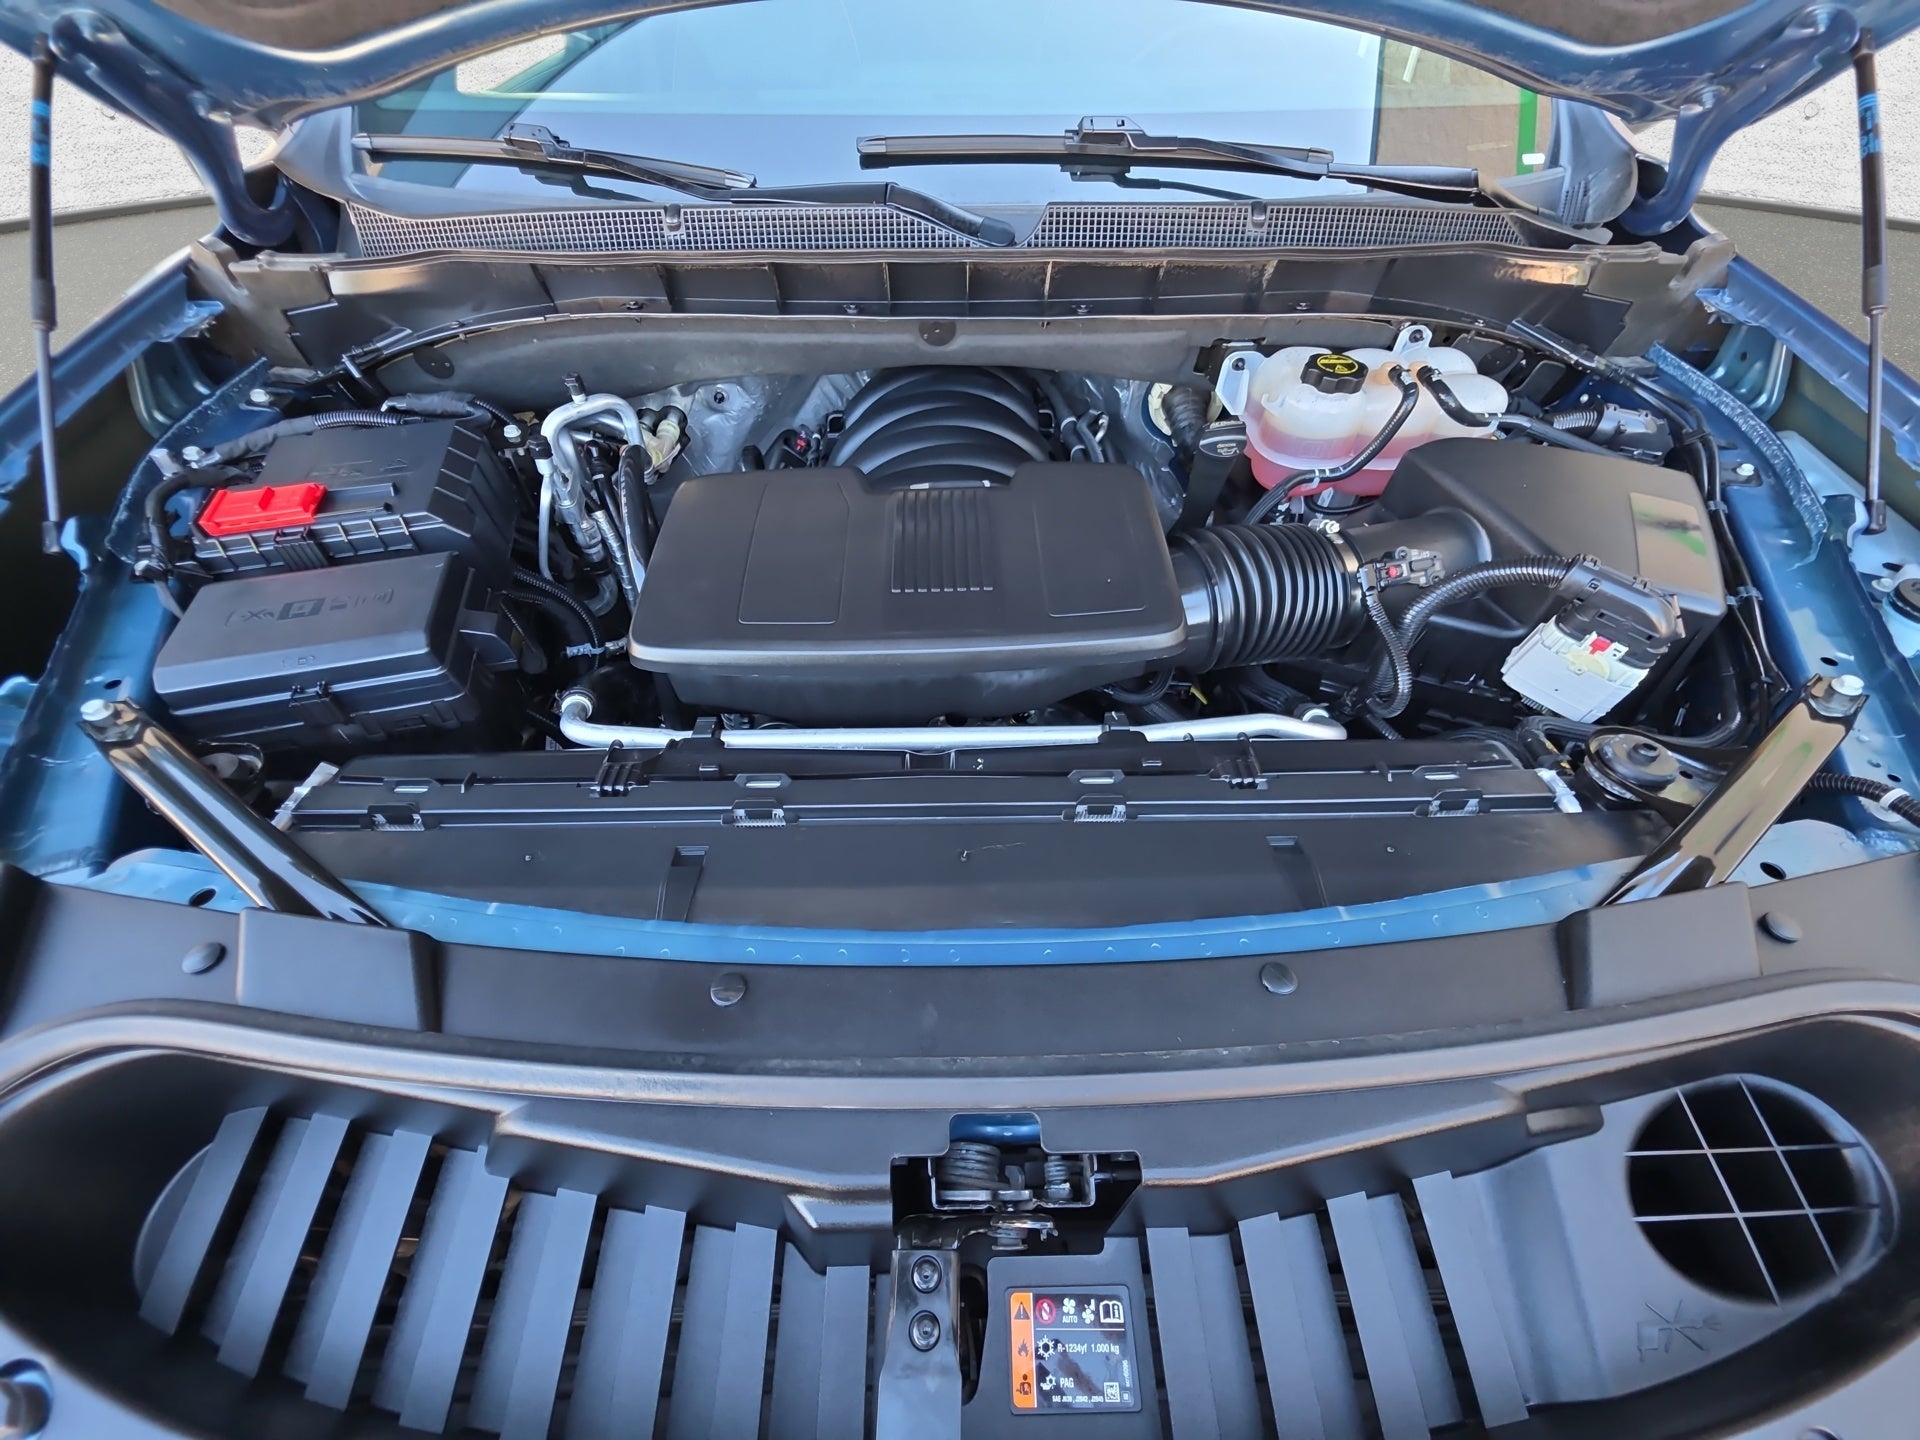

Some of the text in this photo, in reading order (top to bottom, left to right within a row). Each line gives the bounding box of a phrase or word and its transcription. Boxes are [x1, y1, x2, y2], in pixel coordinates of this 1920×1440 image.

[1062, 1315, 1078, 1324] AUTO
[1057, 1343, 1119, 1355] R-1234yf 1.000 kg
[1059, 1377, 1074, 1388] PAG
